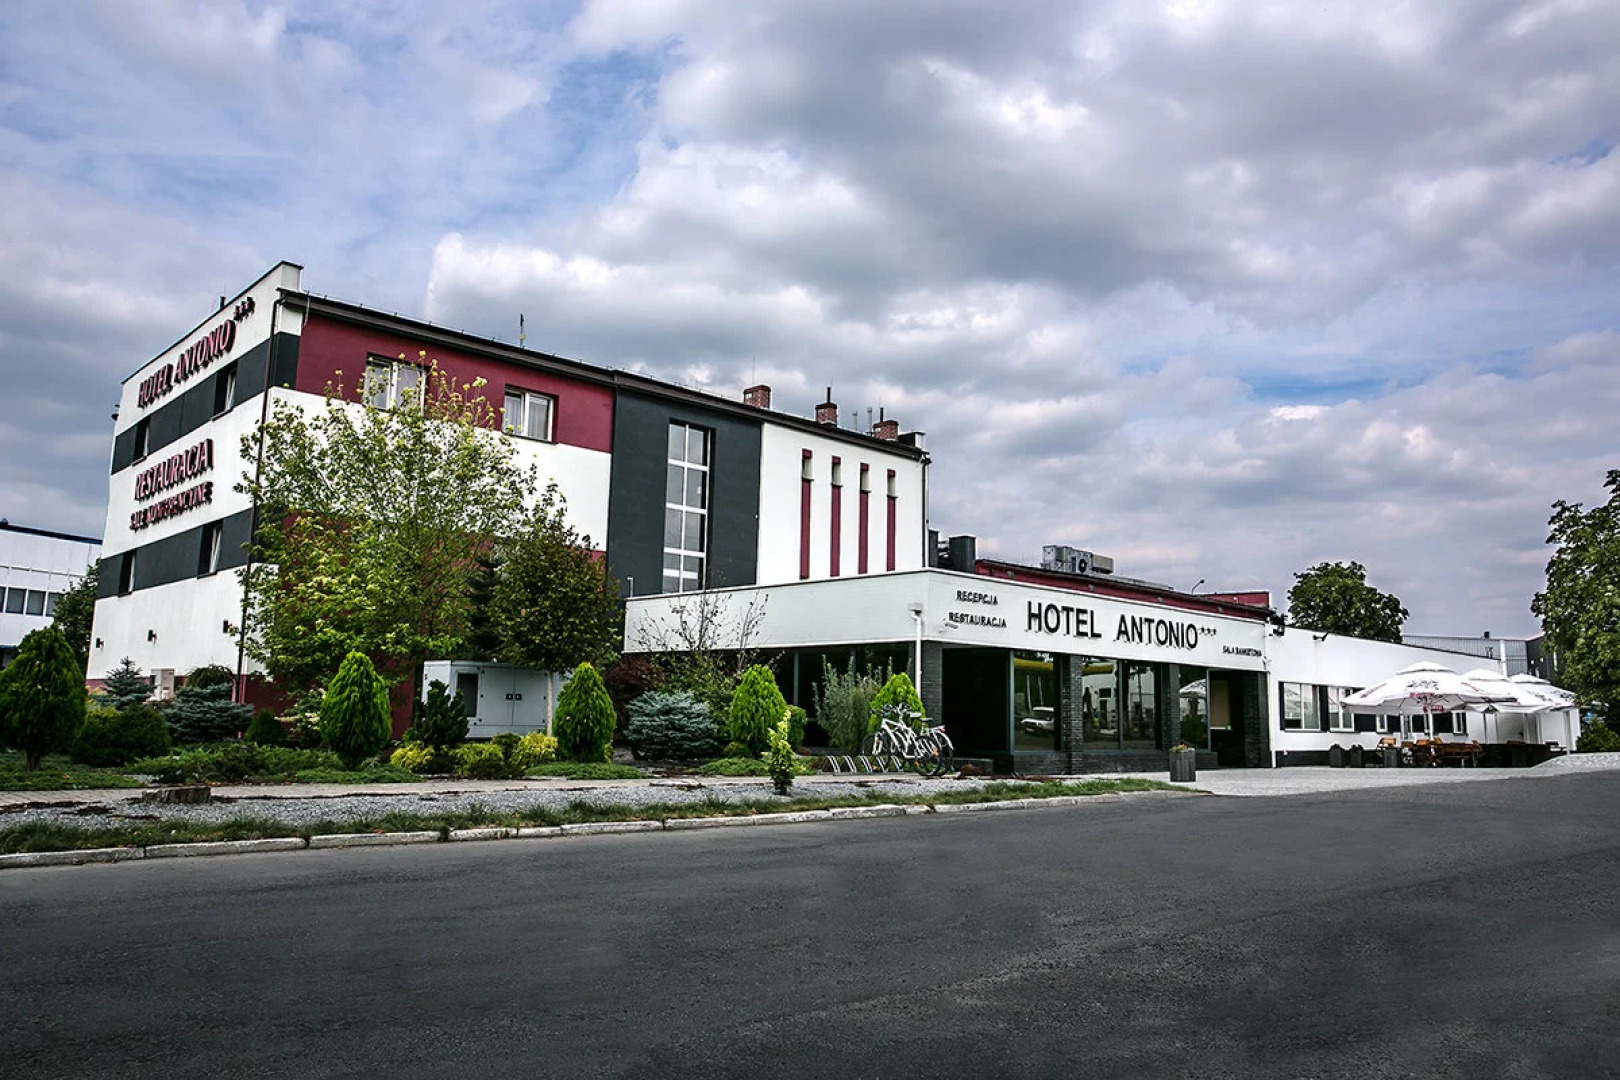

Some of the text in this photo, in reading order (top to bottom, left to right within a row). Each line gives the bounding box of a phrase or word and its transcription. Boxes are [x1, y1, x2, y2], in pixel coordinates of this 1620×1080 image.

[138, 319, 237, 408] HOTEL ANTONIO
[134, 438, 214, 503] RESTAURACJA
[948, 611, 1008, 629] RESTAURACJA
[956, 590, 999, 606] RECEPCJA
[1026, 600, 1198, 650] HOTEL ANTONIO
